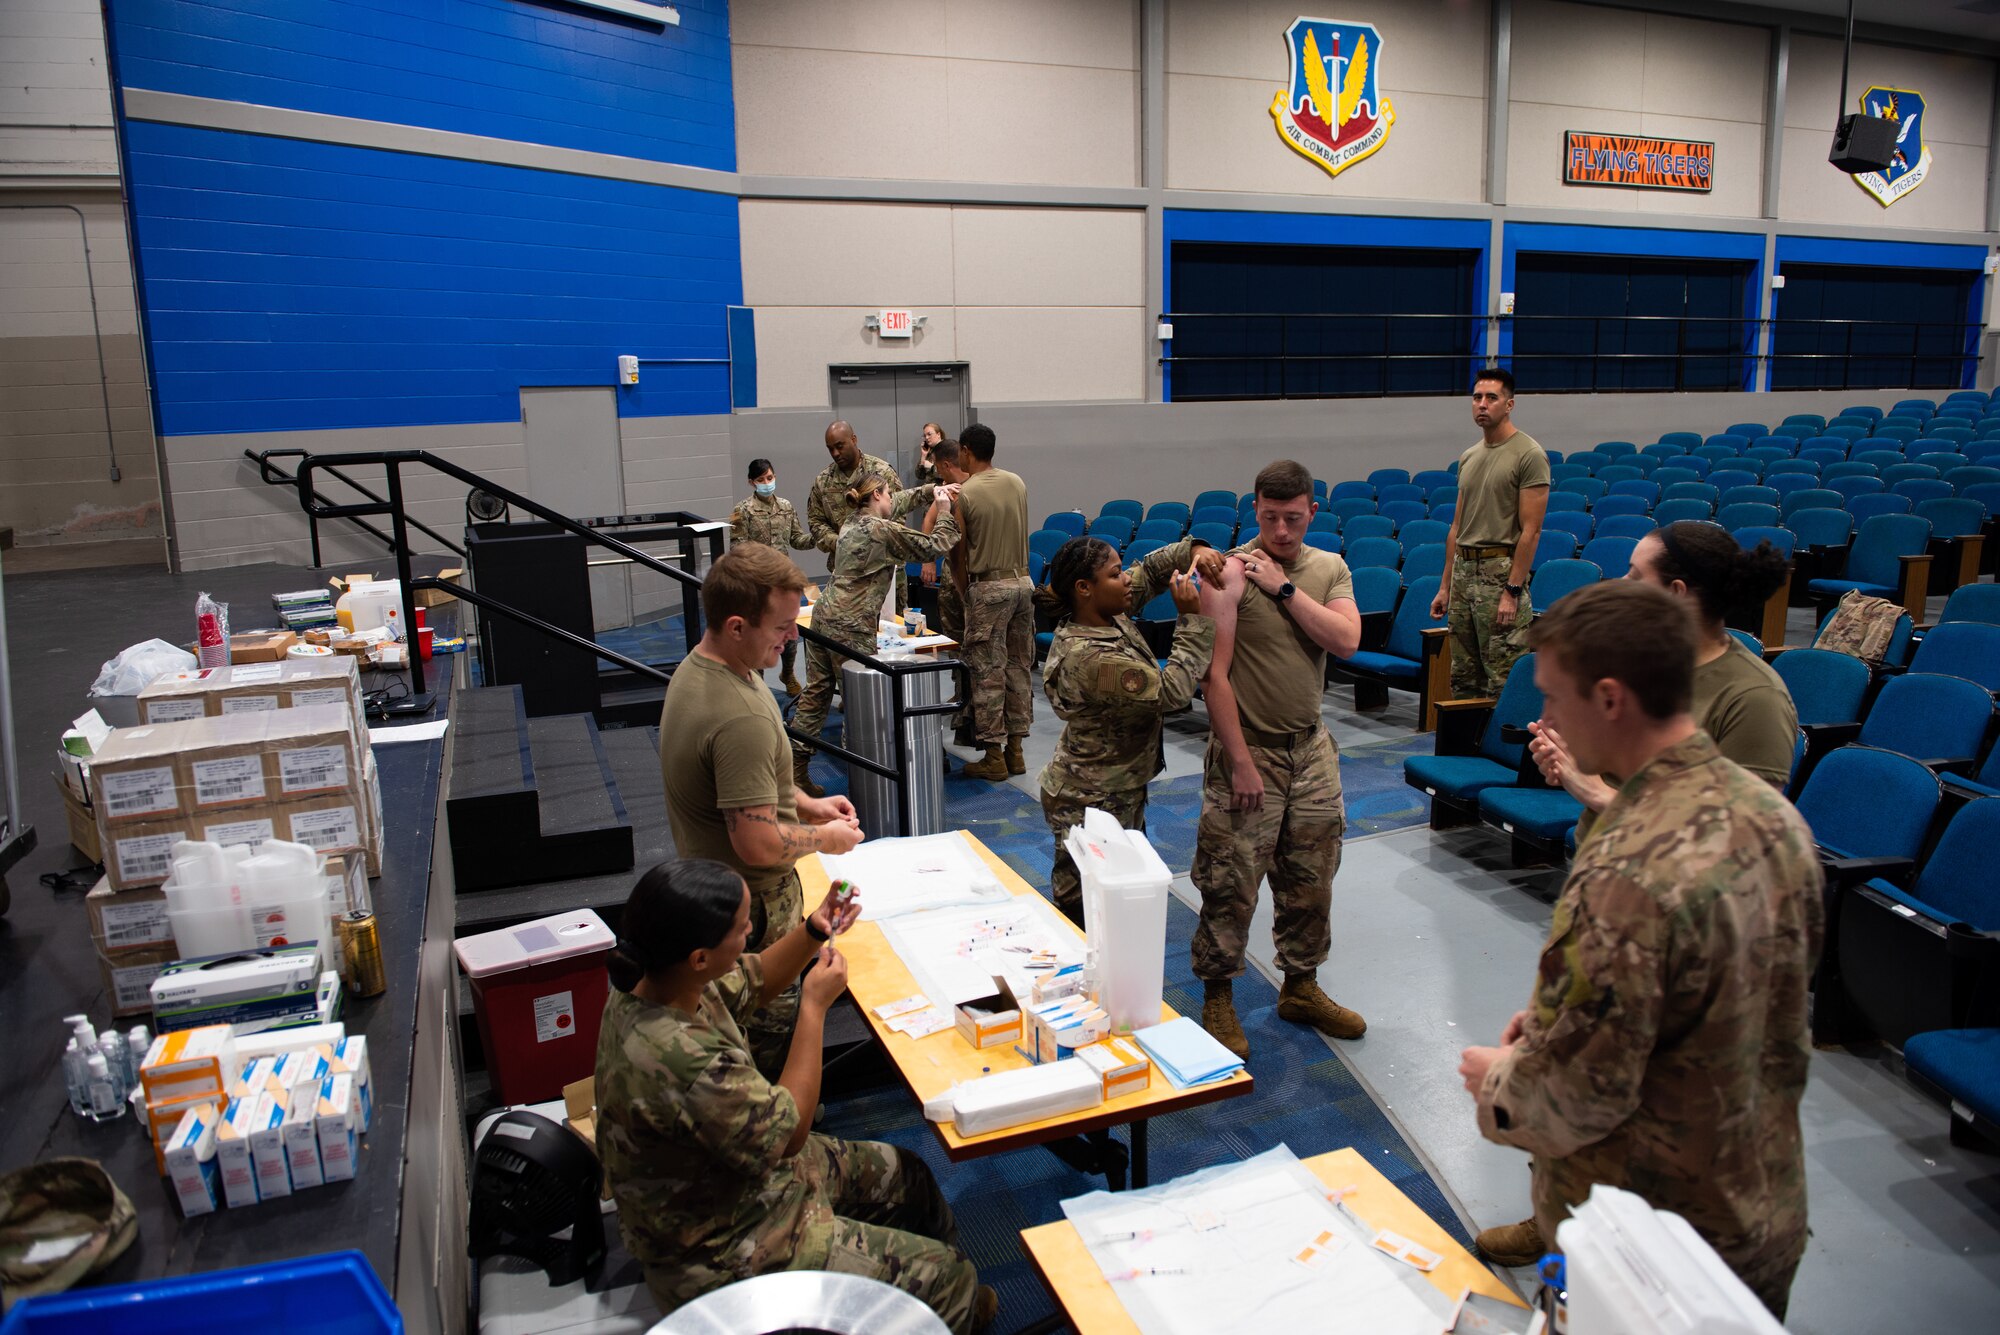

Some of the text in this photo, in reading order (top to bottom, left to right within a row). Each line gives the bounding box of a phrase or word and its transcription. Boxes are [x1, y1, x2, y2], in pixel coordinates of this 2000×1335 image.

[1286, 124, 1383, 165] AIR COMBAT COMMAND
[1571, 147, 1710, 178] FLYING TIGERS
[1891, 169, 1923, 195] TIGERS
[887, 312, 907, 329] EXIT
